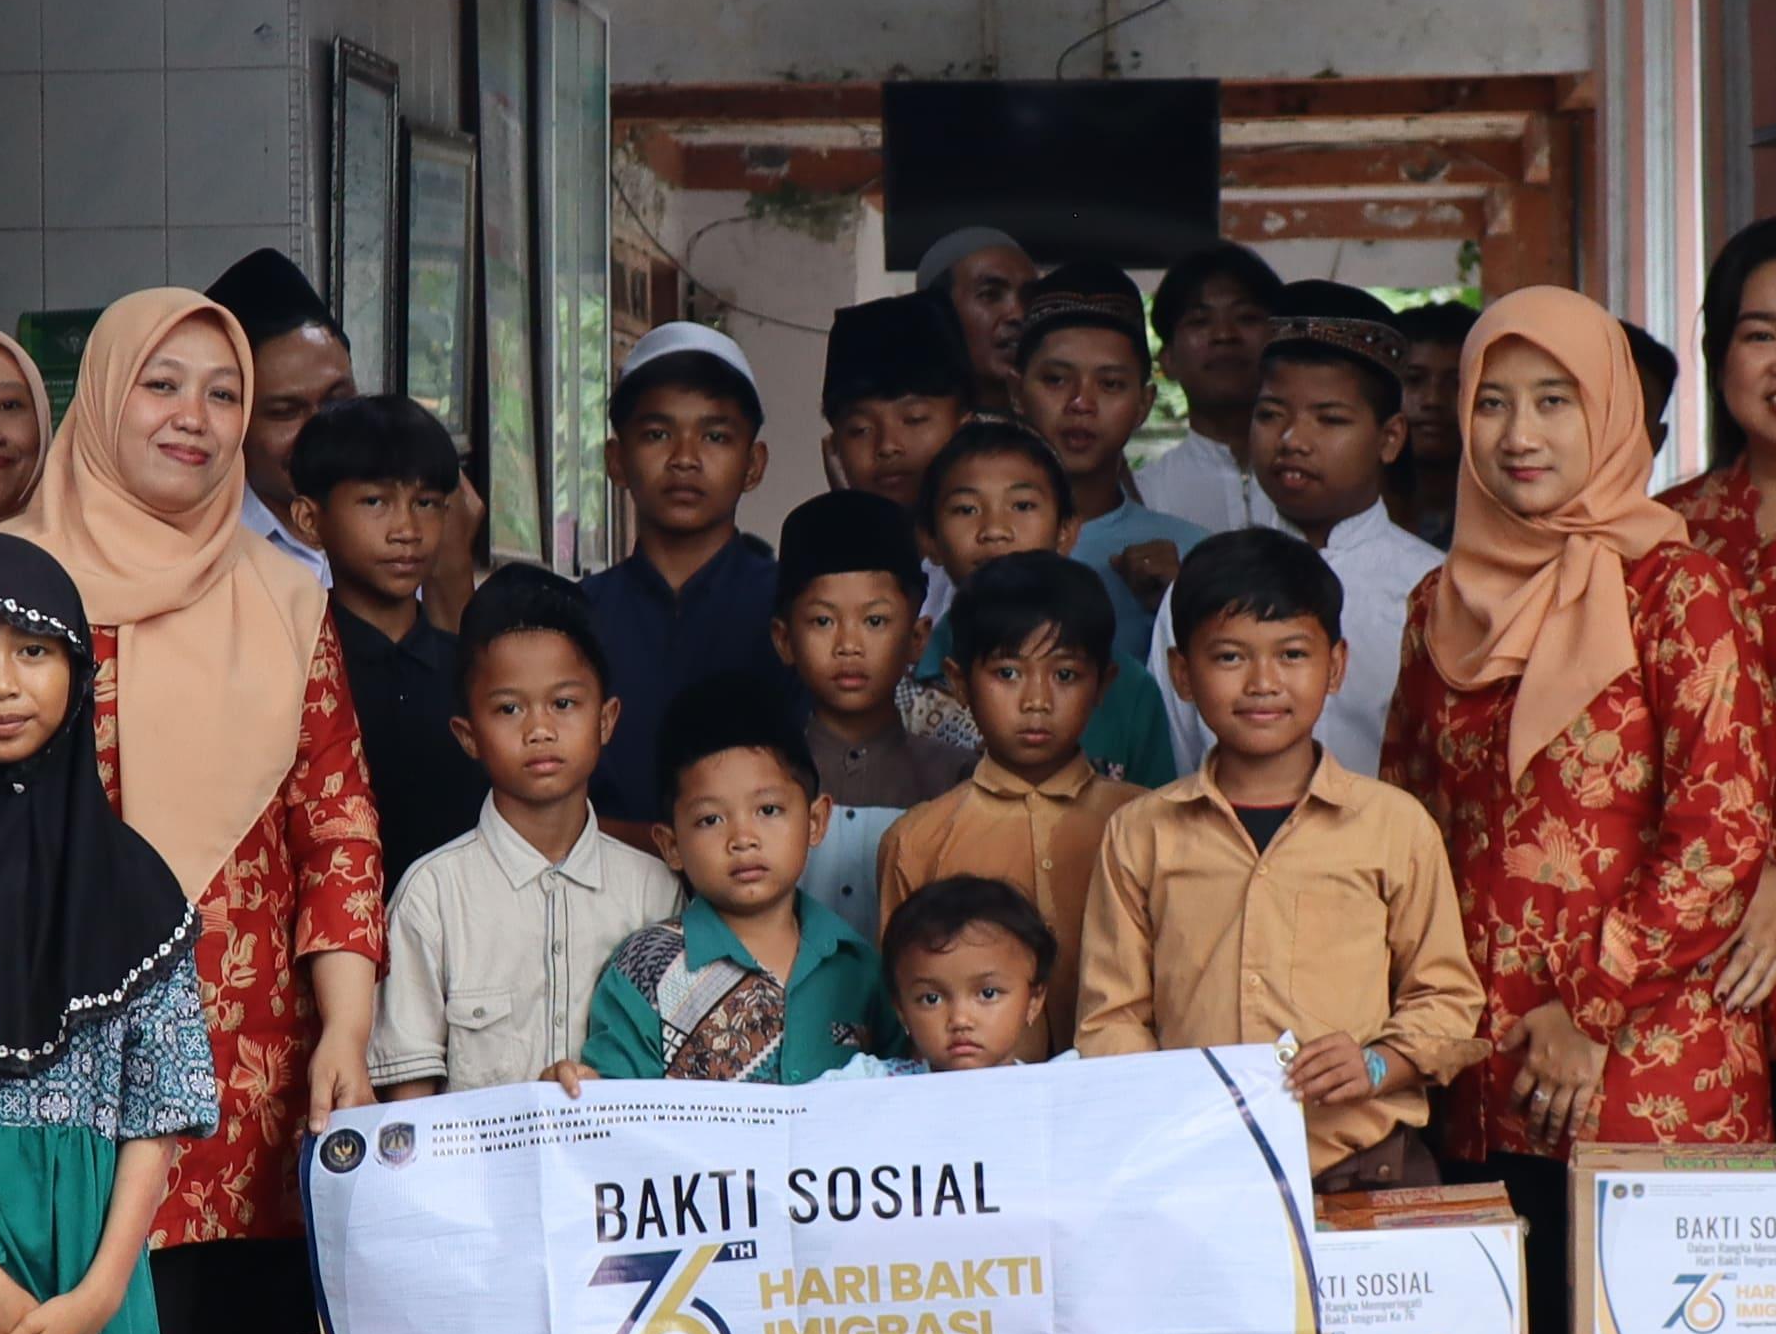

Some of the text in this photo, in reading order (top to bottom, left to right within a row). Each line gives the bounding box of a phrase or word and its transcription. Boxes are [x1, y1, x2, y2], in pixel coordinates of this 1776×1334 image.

[432, 1117, 506, 1131] KEMENTERIAN
[510, 1109, 556, 1123] IMIGRASI
[479, 1128, 525, 1140] WILAYAH
[653, 1114, 704, 1122] IMIGRASI
[707, 1115, 736, 1124] JAWA
[741, 1117, 776, 1125] TIMUR
[480, 1141, 526, 1153] IMIGRASI
[530, 1135, 561, 1146] KELAS
[573, 1130, 612, 1143] JEMBER
[594, 1161, 1001, 1243] BAKTI SOSIAL
[1676, 1216, 1740, 1240] BAKTI
[727, 1241, 755, 1259] TH
[759, 1256, 1044, 1310] HARI BAKTI
[1356, 1272, 1434, 1297] SOSIAL
